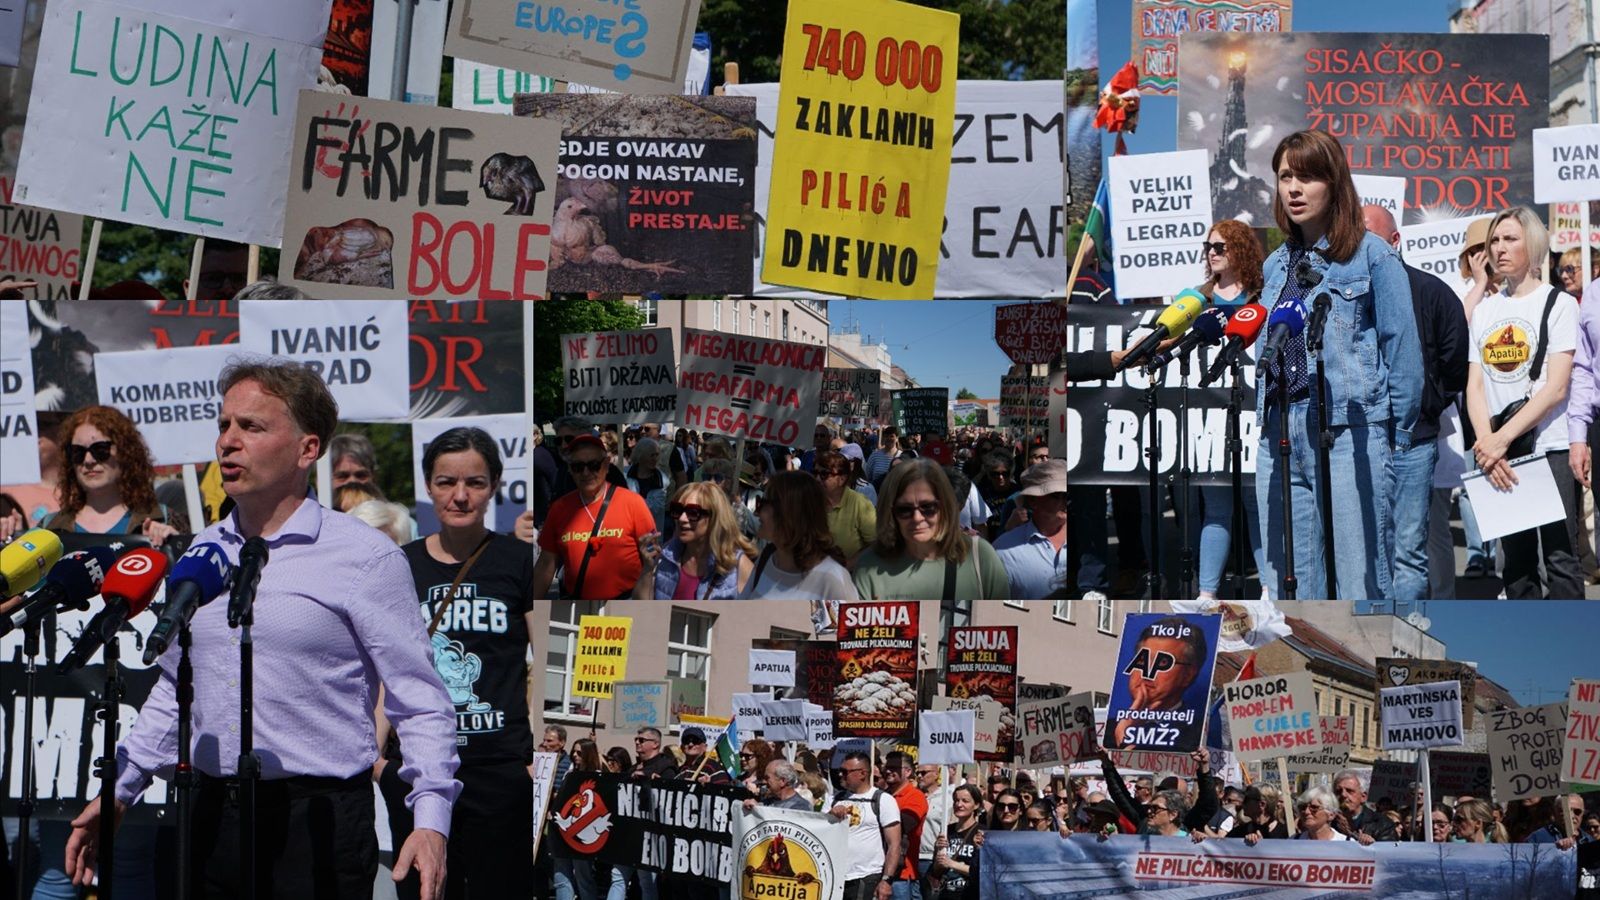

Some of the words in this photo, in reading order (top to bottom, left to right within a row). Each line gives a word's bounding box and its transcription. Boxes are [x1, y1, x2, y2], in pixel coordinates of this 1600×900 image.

[70, 11, 279, 115] LUDINA
[801, 24, 866, 76] 740
[875, 37, 943, 93] 000
[1305, 43, 1444, 74] SISAČKO
[1305, 75, 1530, 107] MOSLAVAČKA
[105, 96, 239, 160] KAŽE
[796, 96, 934, 150] ZAKLANIH
[1306, 106, 1462, 142] ŽUPANIJA
[1471, 113, 1516, 138] NE
[616, 142, 706, 158] OVAKAV
[1345, 144, 1374, 169] LI
[1383, 144, 1512, 170] POSTATI
[1552, 144, 1599, 162] IVAN
[302, 116, 474, 207] FARME
[636, 165, 745, 187] NASTANE,
[1129, 175, 1192, 194] VELIKI
[121, 151, 232, 227] NE
[628, 186, 694, 206] ŽIVOT
[1132, 190, 1193, 214] PAŽUT
[1358, 197, 1397, 210] NICA
[629, 213, 746, 230] PRESTAJE.
[1127, 222, 1206, 242] LEGRAD
[407, 212, 550, 300] BOLE
[782, 229, 919, 287] DNEVNO
[271, 316, 381, 355] IVANIĆ
[568, 338, 588, 360] NE
[596, 332, 657, 358] ŽELIMO
[684, 331, 825, 373] MEGAKLAONICA
[1489, 347, 1523, 361] Apatija
[305, 358, 371, 385] RAD
[569, 366, 601, 389] BITI
[610, 362, 673, 387] DRŽAVA
[681, 371, 800, 409] MEGAFARMA
[565, 398, 619, 417] EKOLOŠKE
[844, 606, 911, 627] SUNJA
[584, 626, 602, 641] 740
[604, 626, 626, 641] 000
[855, 628, 870, 638] NE
[872, 625, 896, 637] ŽELI
[954, 630, 1010, 651] SUNJA
[1151, 624, 1175, 637] Tko
[1175, 625, 1191, 639] je
[581, 645, 623, 657] ZAKLANIH
[839, 638, 868, 649] TROVANJE
[962, 652, 975, 662] NE
[977, 651, 997, 662] ŽELI
[1123, 647, 1176, 681] AP
[754, 663, 791, 674] APATIJA
[1227, 678, 1287, 702] HOROR
[1383, 689, 1458, 707] MARTINSKA
[950, 699, 982, 711] MEGA
[1231, 694, 1294, 720] PROBLEM
[1409, 706, 1434, 719] VES
[460, 711, 505, 731] LOVE
[765, 715, 802, 727] LEKENIK
[838, 721, 865, 730] SPASIMO
[865, 719, 882, 729] NAŠU
[882, 720, 908, 730] SUNJU!
[1024, 701, 1074, 737] FARME
[1116, 707, 1195, 725] prodavatelj
[1254, 712, 1311, 732] CIJELE
[930, 731, 965, 744] SUNJA
[1124, 723, 1180, 746] SMŽ?
[1238, 729, 1318, 752] HRVATSKE
[1388, 725, 1457, 743] MAHOVO
[1287, 752, 1350, 768] PRISTAJEMO?
[1501, 754, 1518, 772] MI
[641, 831, 668, 870] EKO
[763, 825, 792, 835] FARMI
[795, 830, 823, 859] PILIĆA
[1136, 857, 1158, 875] NE
[1160, 855, 1265, 880] PILIĆARSKOJ
[1267, 863, 1303, 882] EKO
[1305, 865, 1375, 884] BOMBI!
[748, 882, 807, 900] Apatija
